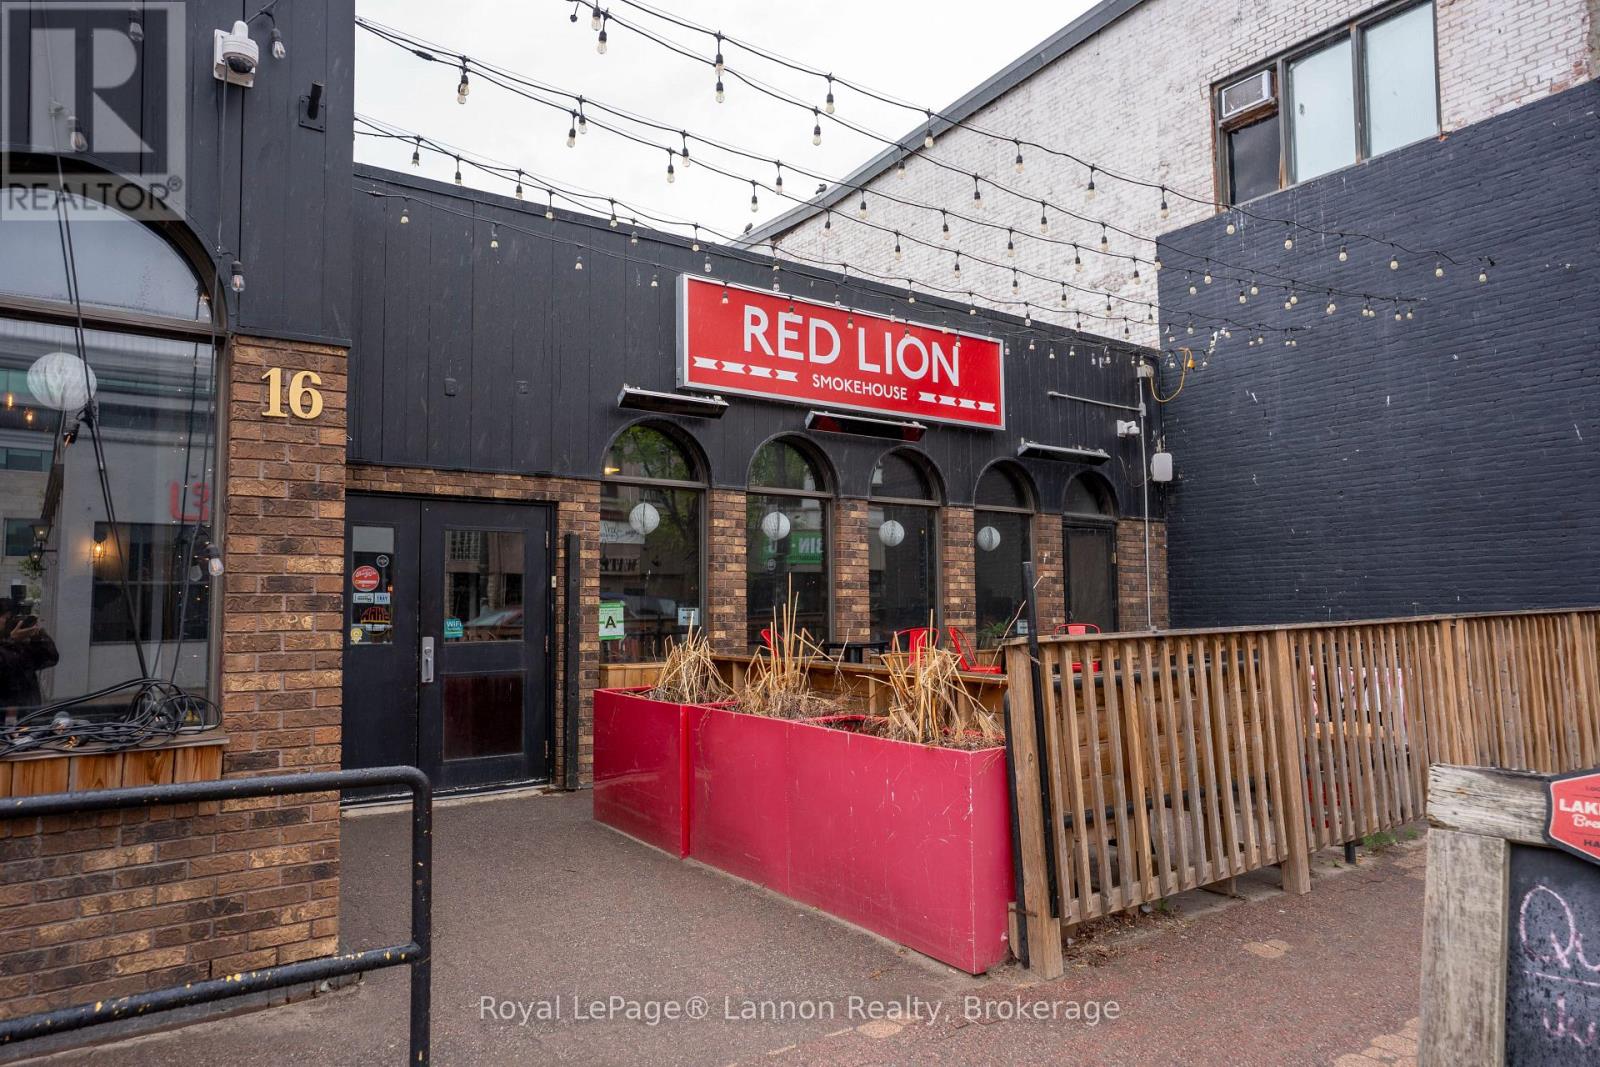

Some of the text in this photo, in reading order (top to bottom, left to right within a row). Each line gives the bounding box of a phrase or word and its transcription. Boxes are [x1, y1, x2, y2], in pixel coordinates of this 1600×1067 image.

[743, 304, 960, 387] RED LION
[261, 368, 323, 419] 16
[812, 374, 907, 400] SMOKEHOUSE
[605, 615, 617, 629] A
[1559, 798, 1600, 816] LAK
